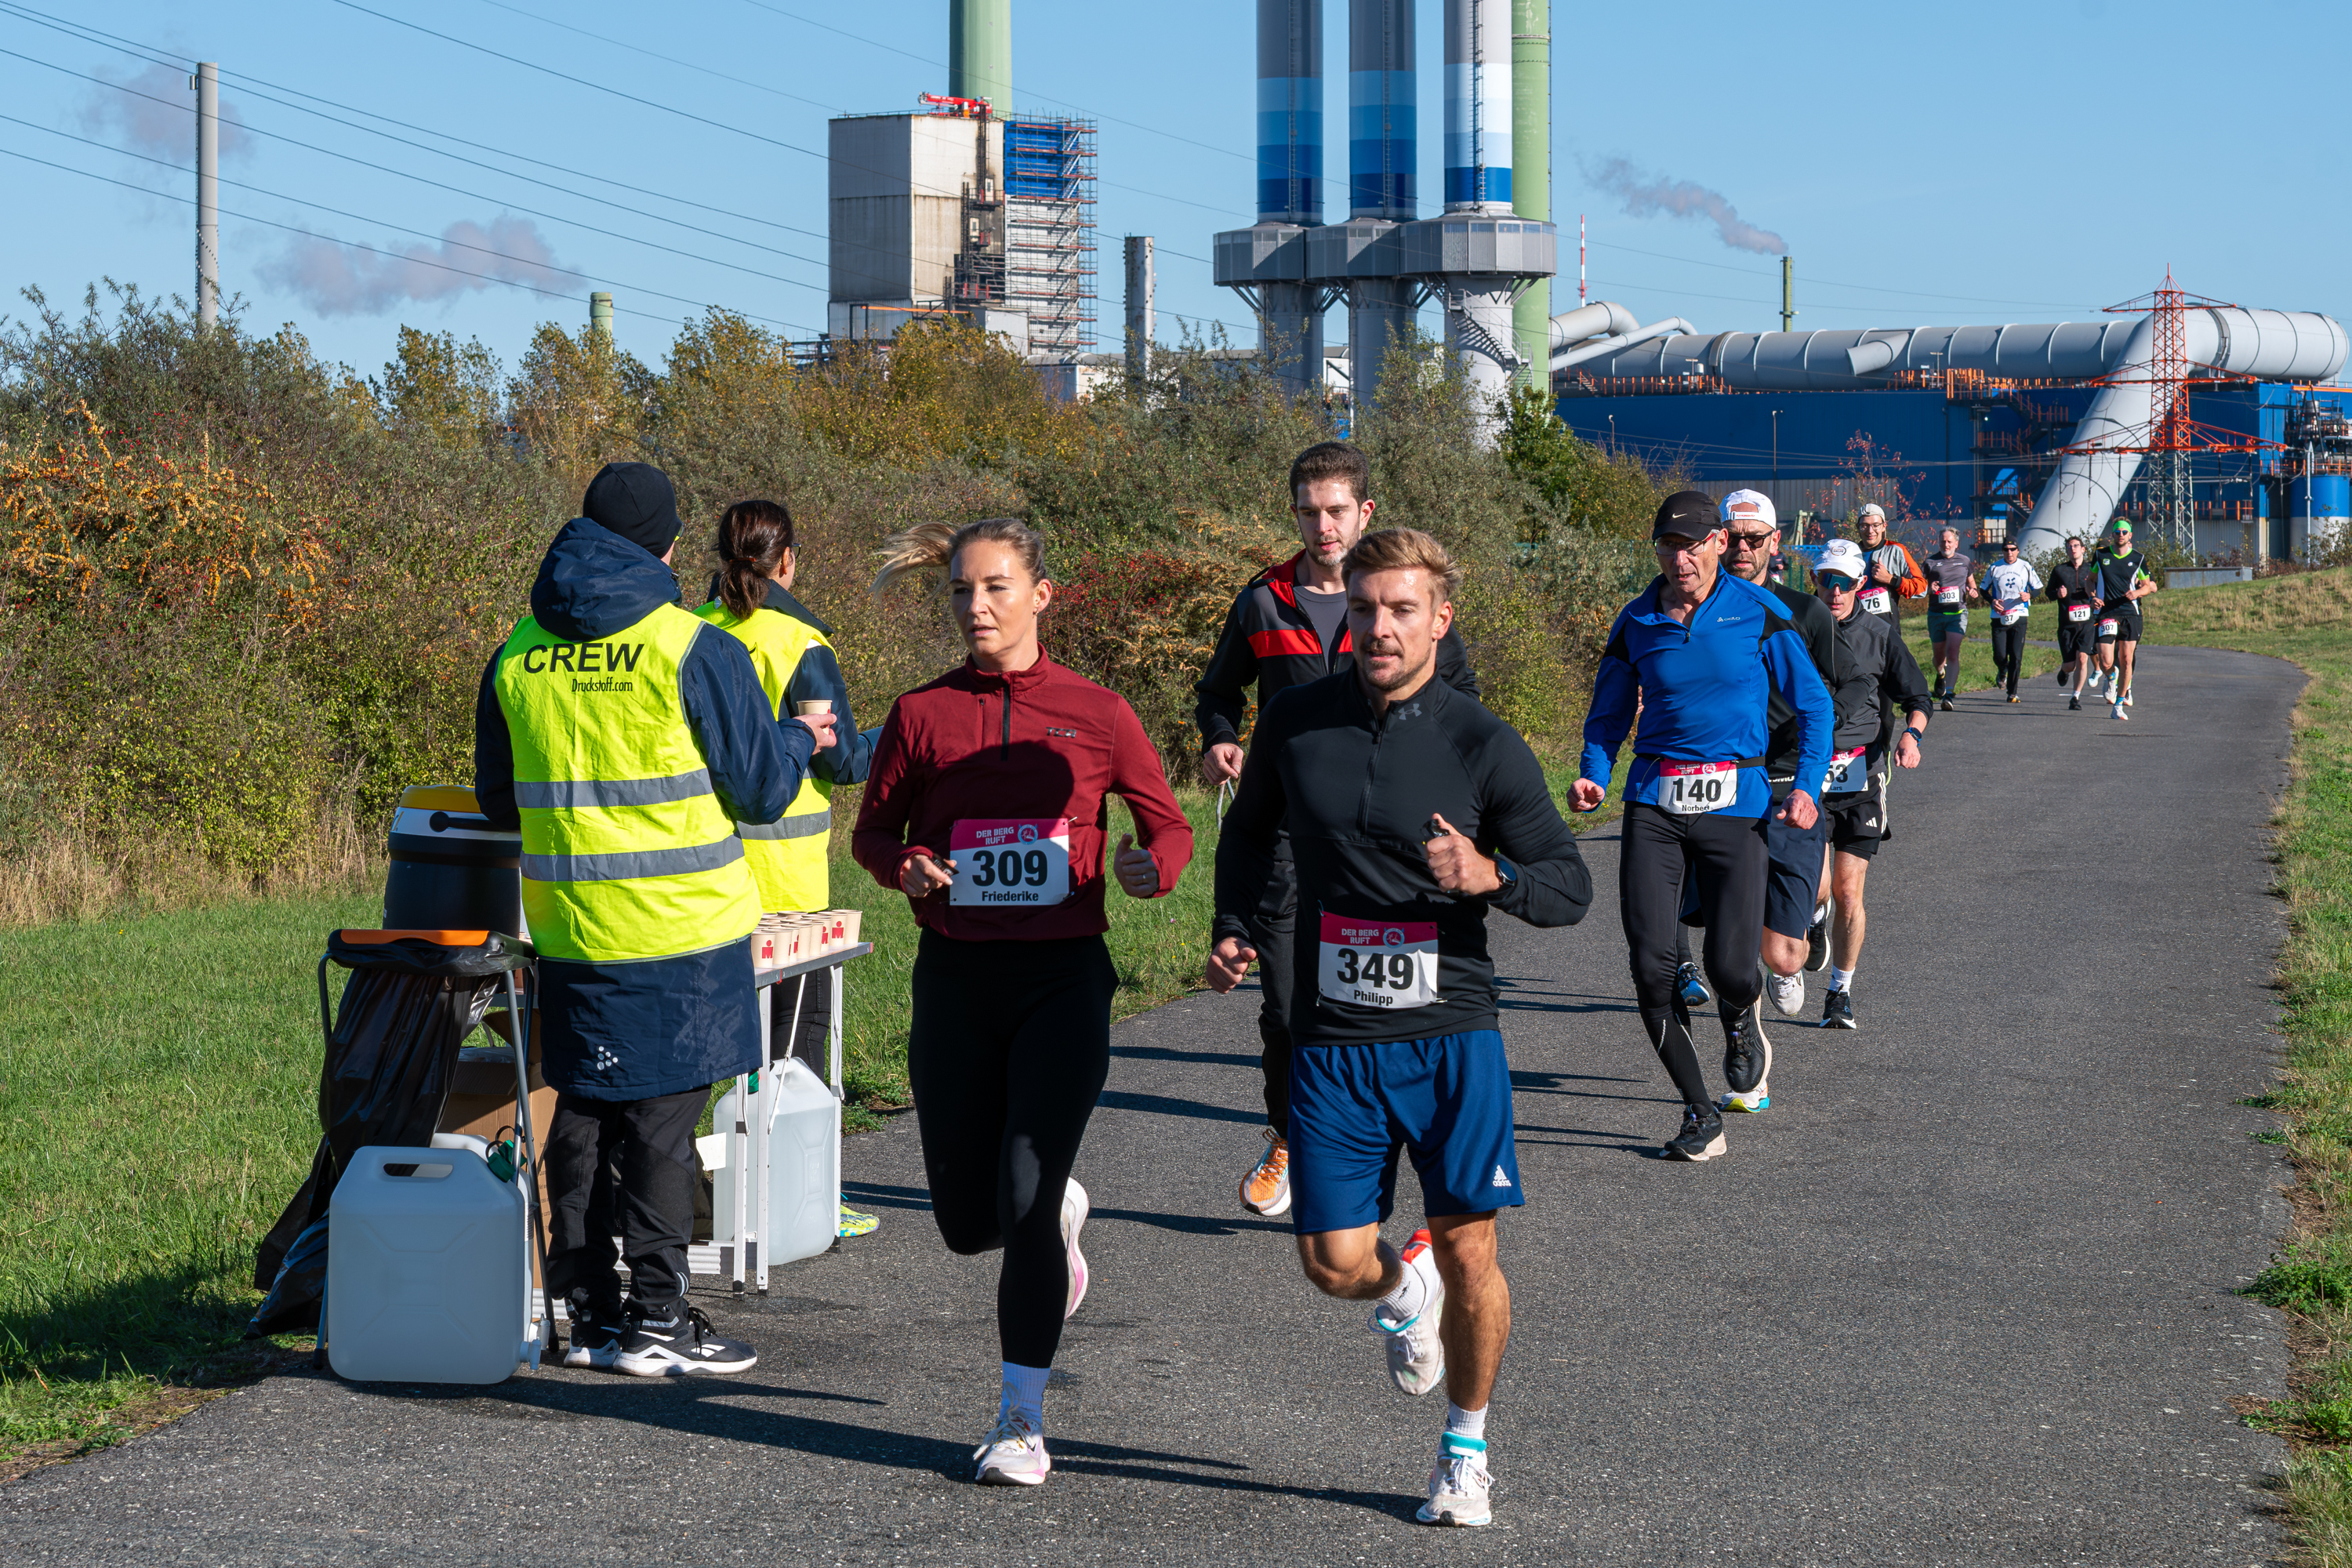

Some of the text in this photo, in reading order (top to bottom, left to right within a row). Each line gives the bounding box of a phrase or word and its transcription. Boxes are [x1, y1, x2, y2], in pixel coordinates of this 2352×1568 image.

[1865, 597, 1880, 609] 76
[524, 643, 644, 674] CREW
[572, 677, 633, 692] Druckstoff.com
[1046, 727, 1076, 738] TCA
[1673, 778, 1722, 802] 140
[976, 829, 992, 838] DER
[993, 826, 1014, 837] BERG
[985, 836, 1006, 845] RUFT
[972, 850, 1047, 887] 309
[982, 891, 1039, 902] Friederike
[1337, 948, 1414, 990] 349
[1354, 989, 1393, 1007] Philipp
